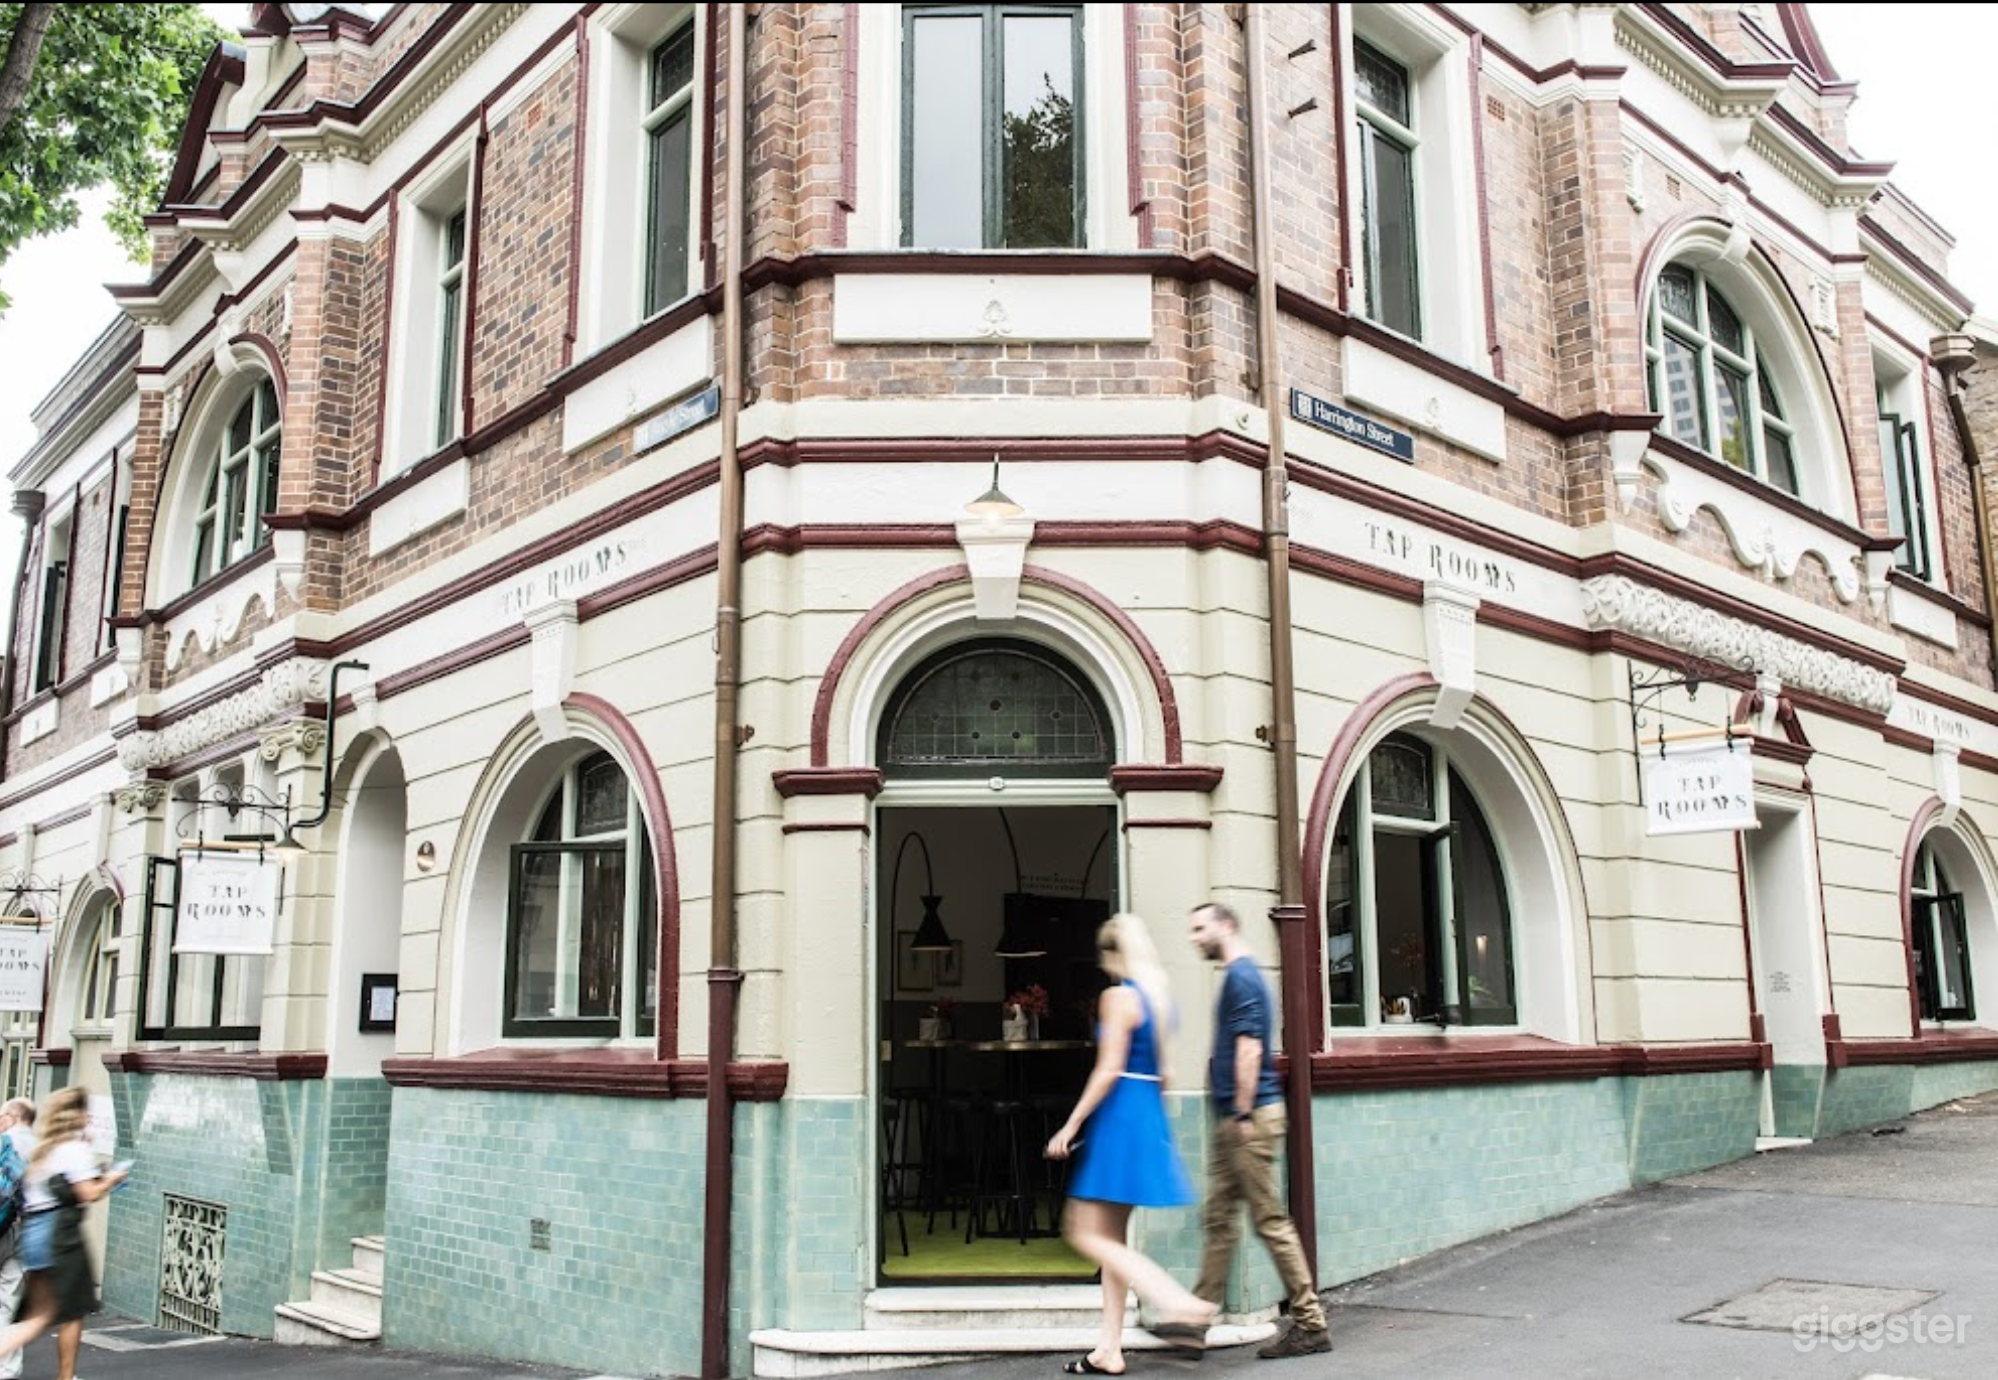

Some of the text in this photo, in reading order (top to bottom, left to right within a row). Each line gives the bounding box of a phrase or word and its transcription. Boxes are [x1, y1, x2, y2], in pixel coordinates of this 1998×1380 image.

[1314, 401, 1395, 447] Harrington Street
[1365, 522, 1515, 592] TAP ROOMS
[502, 543, 627, 615] TAP ROOMS
[1677, 776, 1721, 792] TAP
[1658, 795, 1748, 821] ROOMS
[208, 885, 249, 899] TAP
[187, 902, 266, 920] ROOMS
